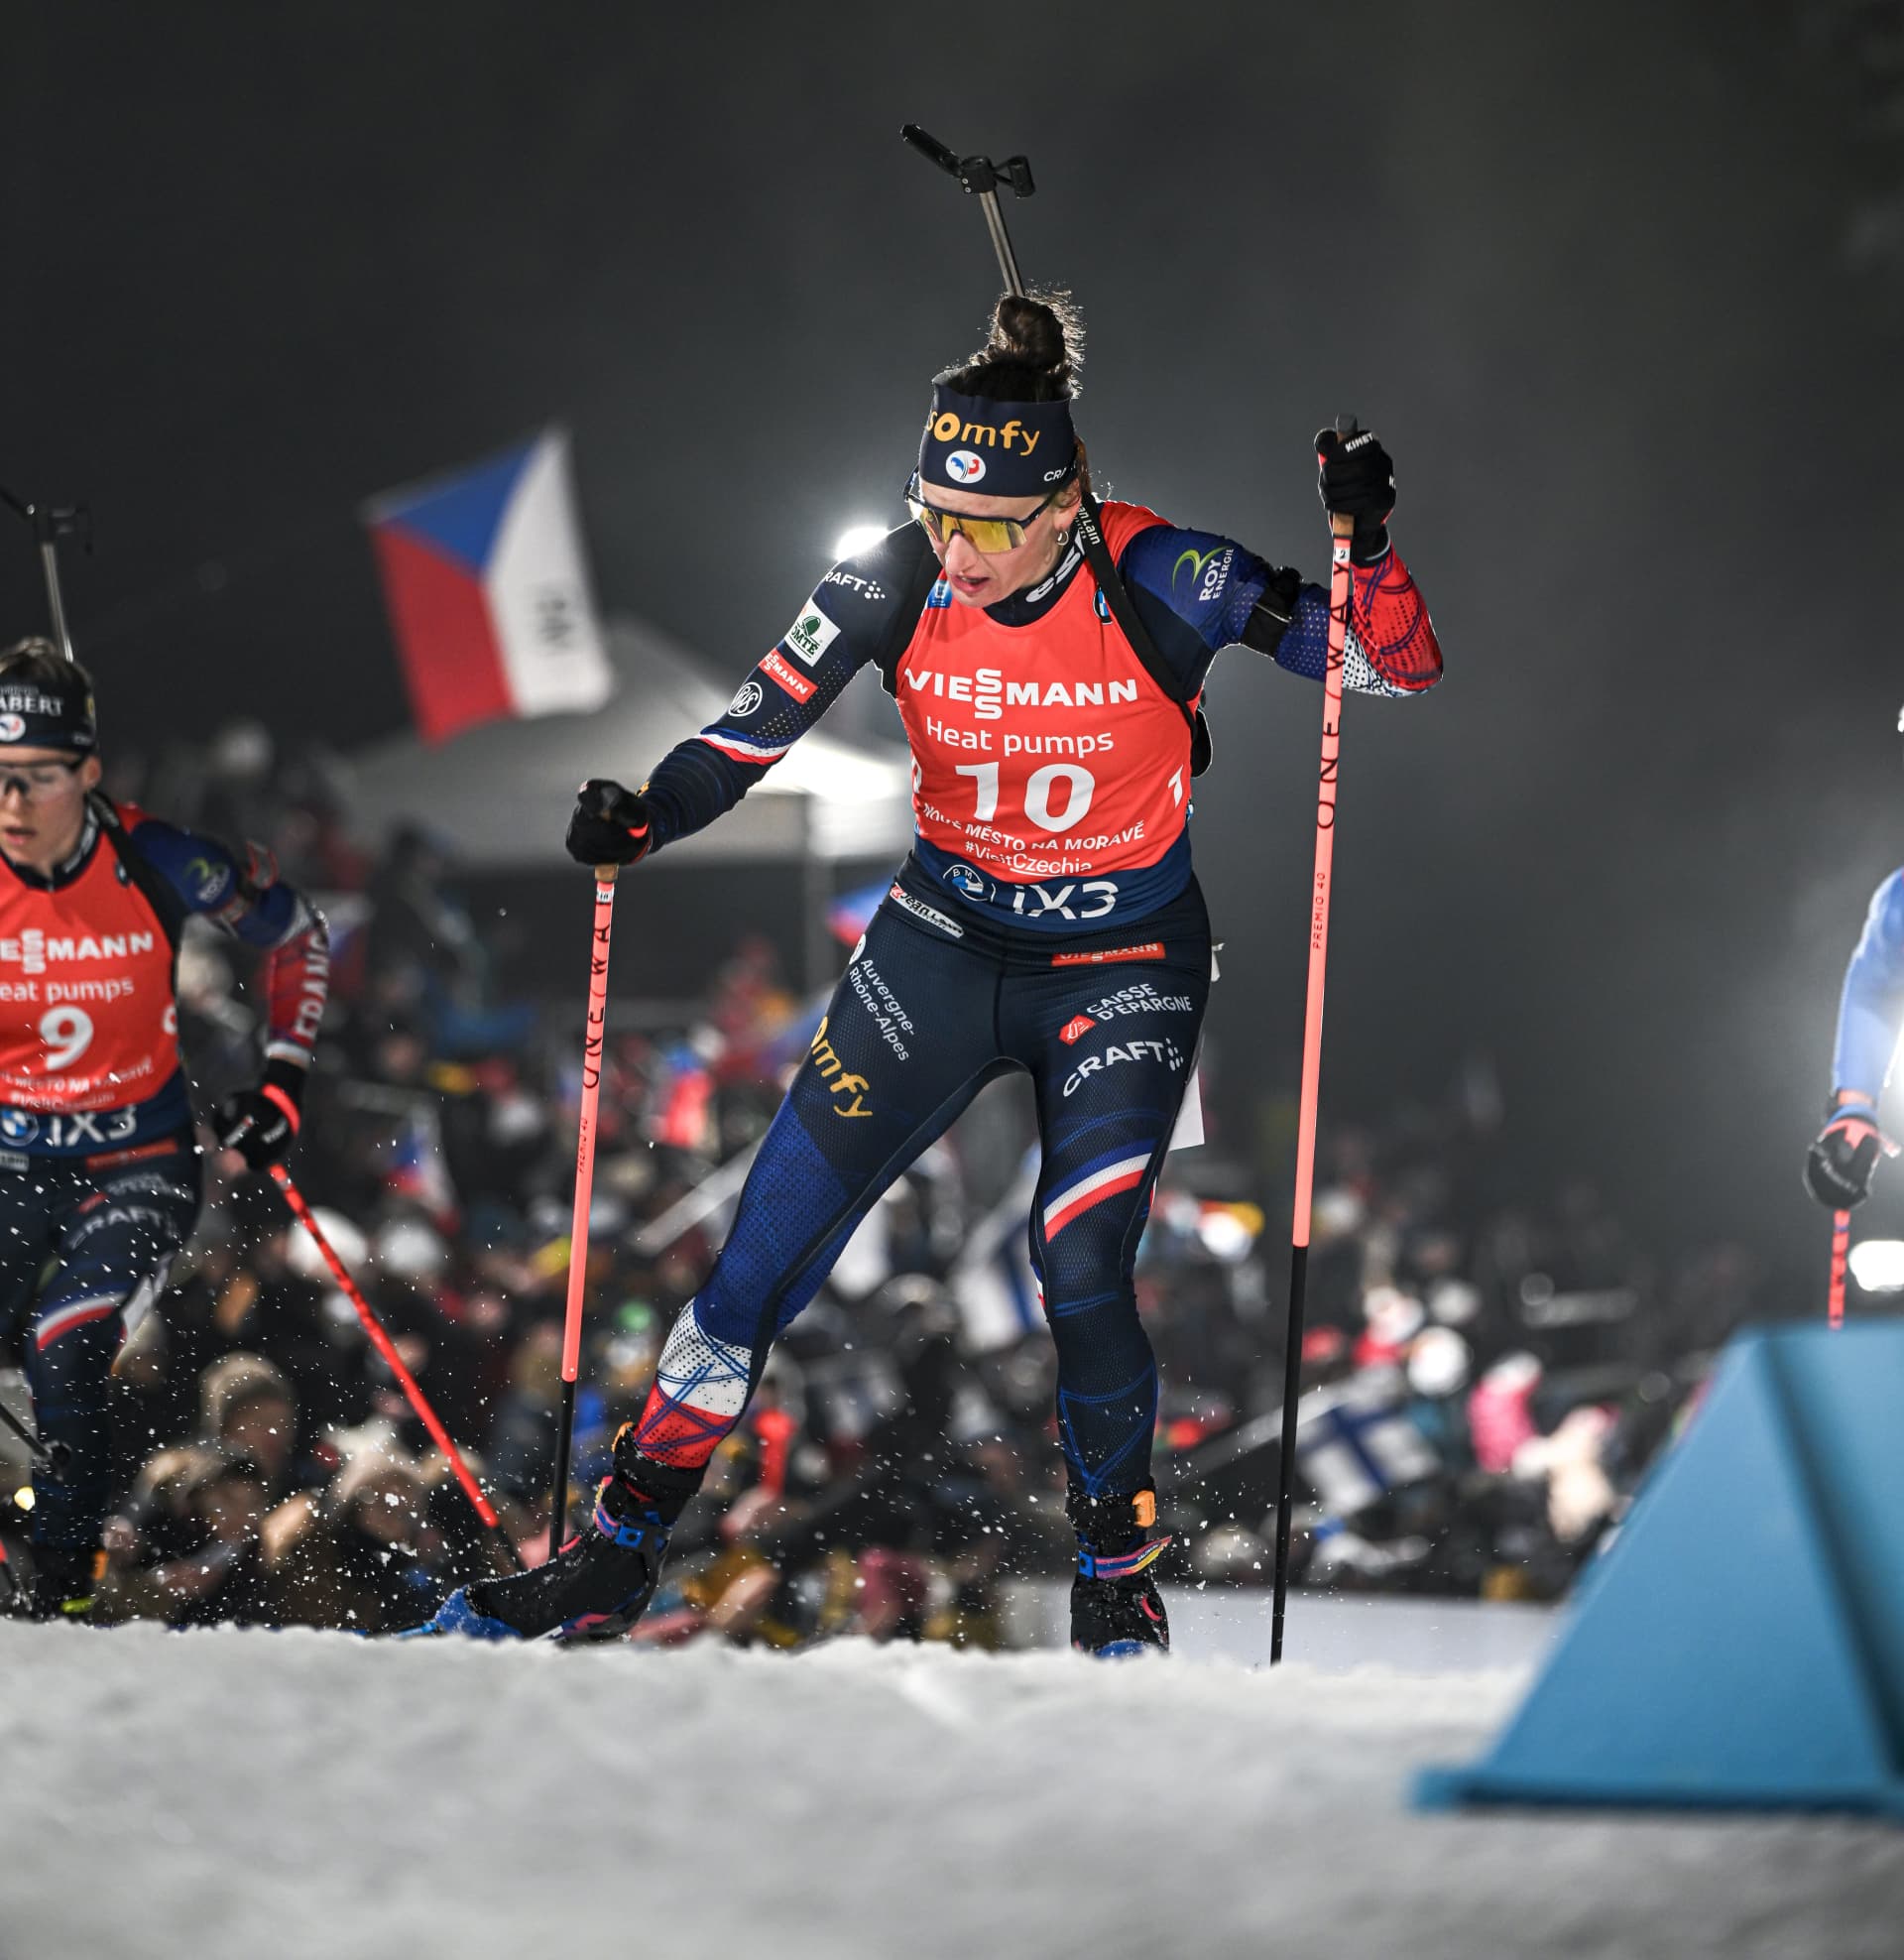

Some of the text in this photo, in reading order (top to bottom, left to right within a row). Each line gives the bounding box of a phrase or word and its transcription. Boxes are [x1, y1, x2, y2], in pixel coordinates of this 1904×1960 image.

[824, 571, 868, 592] RAFT
[1198, 558, 1221, 602] ROY
[764, 651, 809, 695] ESSMANN
[903, 668, 1138, 720] VIESSMANN
[926, 715, 1115, 759] Heat pumps
[955, 761, 1096, 833] 10
[1312, 872, 1326, 949] PREMIO 40
[0, 976, 135, 1006] eat pumps
[849, 966, 910, 1061] Rhône-Alpes
[860, 958, 915, 1037] Auvergne-
[1086, 983, 1157, 1014] CAISSE
[1096, 996, 1194, 1022] D'EPARGNE
[39, 1004, 94, 1071] 9
[1062, 1041, 1165, 1098] CRAFT
